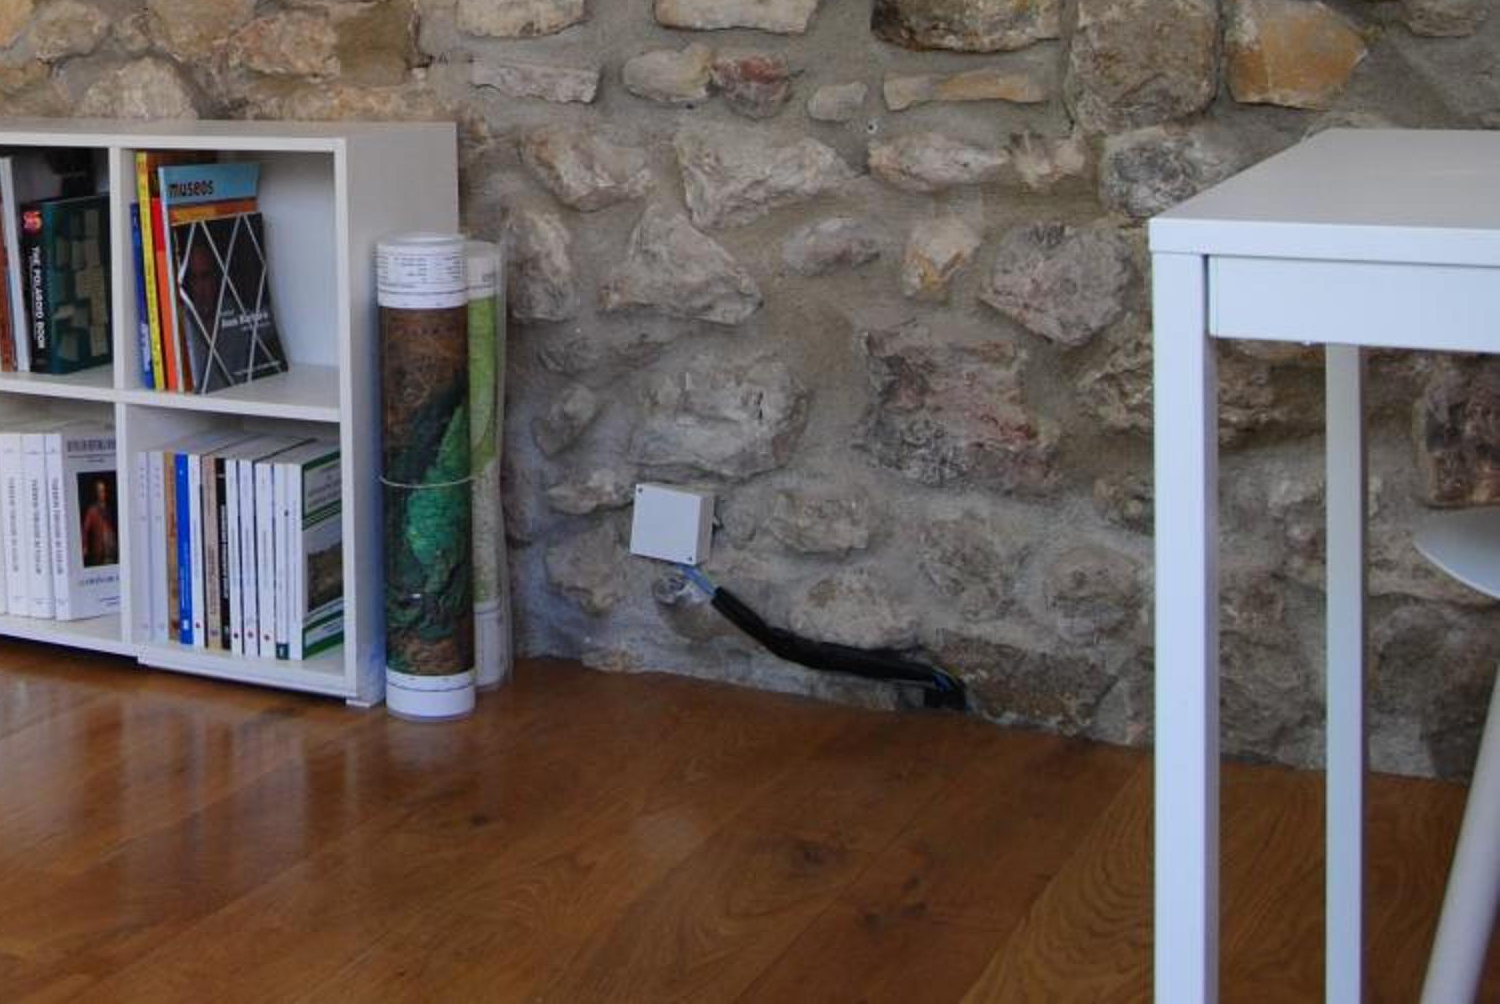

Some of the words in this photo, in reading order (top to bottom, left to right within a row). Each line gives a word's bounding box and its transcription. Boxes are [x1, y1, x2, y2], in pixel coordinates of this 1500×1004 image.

[167, 180, 214, 197] museos
[30, 245, 41, 266] THE
[33, 267, 46, 319] POLAROID
[35, 321, 46, 350] BOOK
